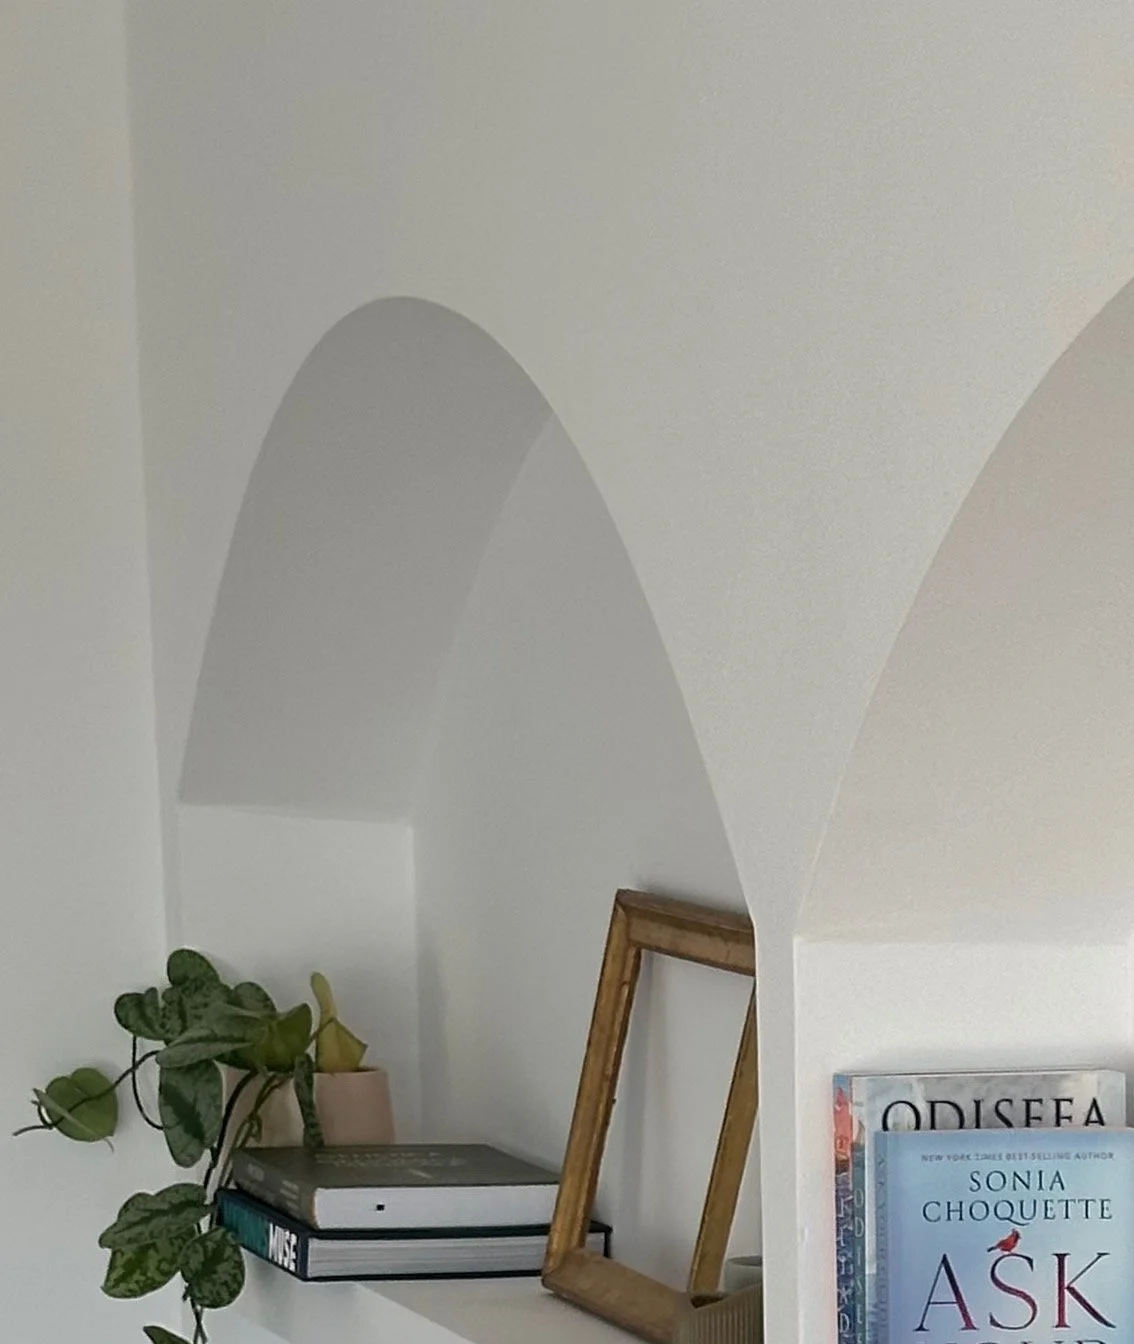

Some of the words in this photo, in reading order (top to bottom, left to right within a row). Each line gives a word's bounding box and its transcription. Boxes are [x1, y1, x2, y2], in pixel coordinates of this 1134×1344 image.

[946, 1154, 971, 1162] YORK
[1075, 1152, 1116, 1160] AUTHOR
[968, 1169, 1066, 1192] SONIA
[922, 1199, 1114, 1227] CHOQUETTE
[913, 1252, 1117, 1331] ASK
